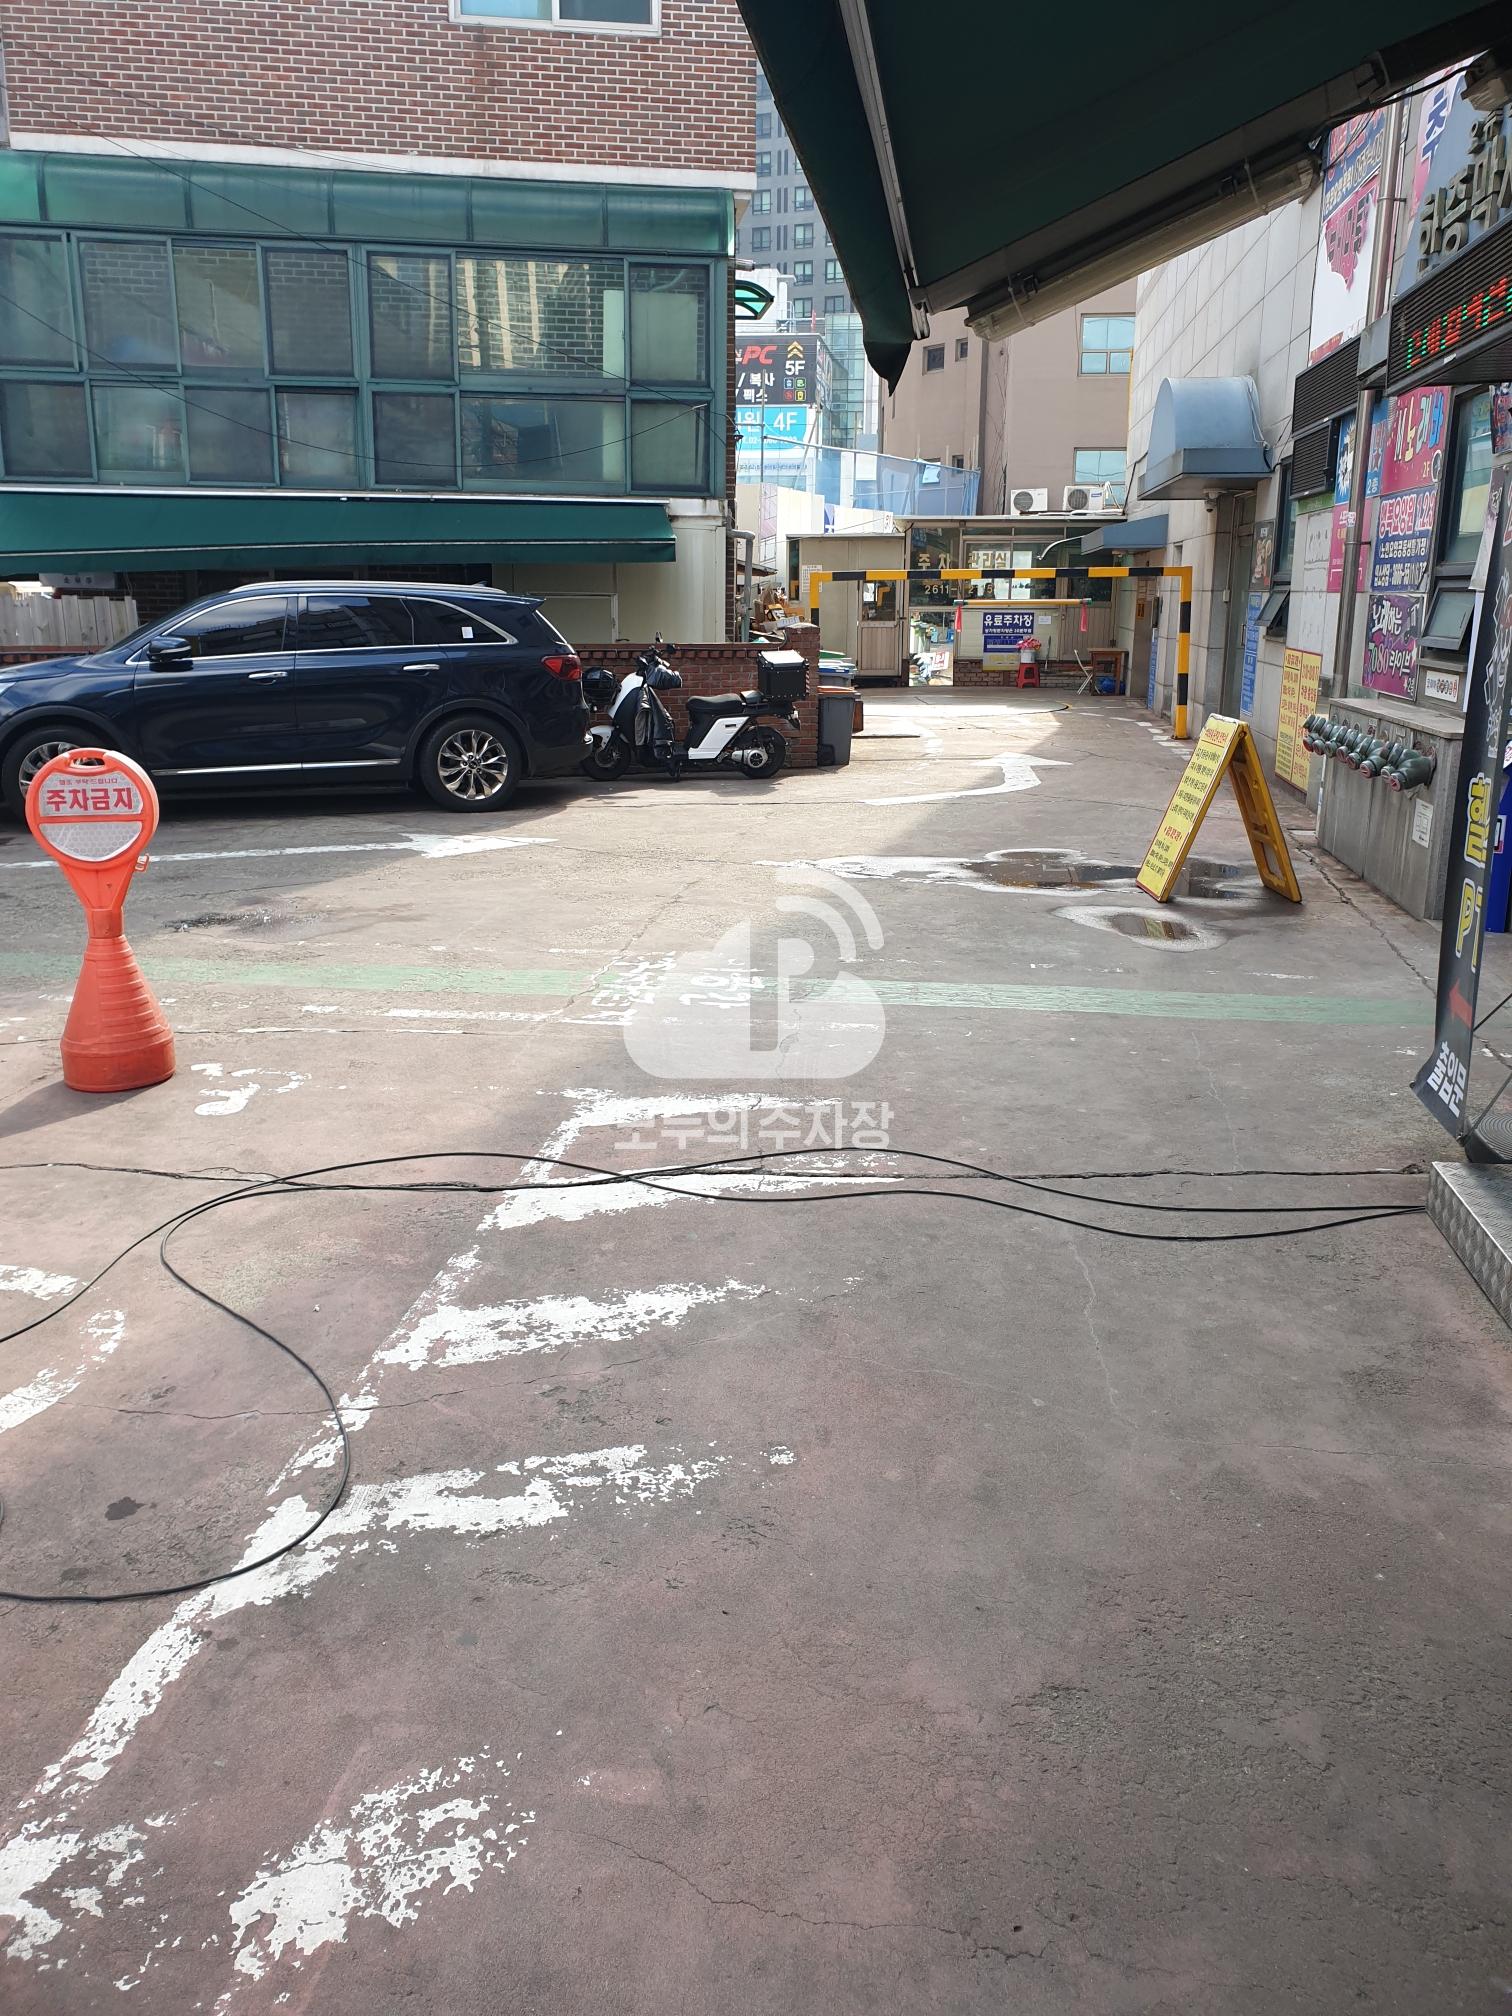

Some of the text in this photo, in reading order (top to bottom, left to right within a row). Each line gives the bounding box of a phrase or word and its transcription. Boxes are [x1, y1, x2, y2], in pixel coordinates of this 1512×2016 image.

[784, 360, 805, 376] 5F
[773, 411, 798, 431] 4F
[1422, 461, 1431, 478] 2F
[1379, 494, 1417, 538] 행복요양원
[967, 551, 1007, 568] 관리실
[983, 614, 1033, 627] 유료주차장
[1371, 599, 1403, 636] 노래하는
[1368, 642, 1411, 677] 7080 라이브
[47, 787, 133, 812] 주차금지
[1426, 1040, 1468, 1119] 출입문
